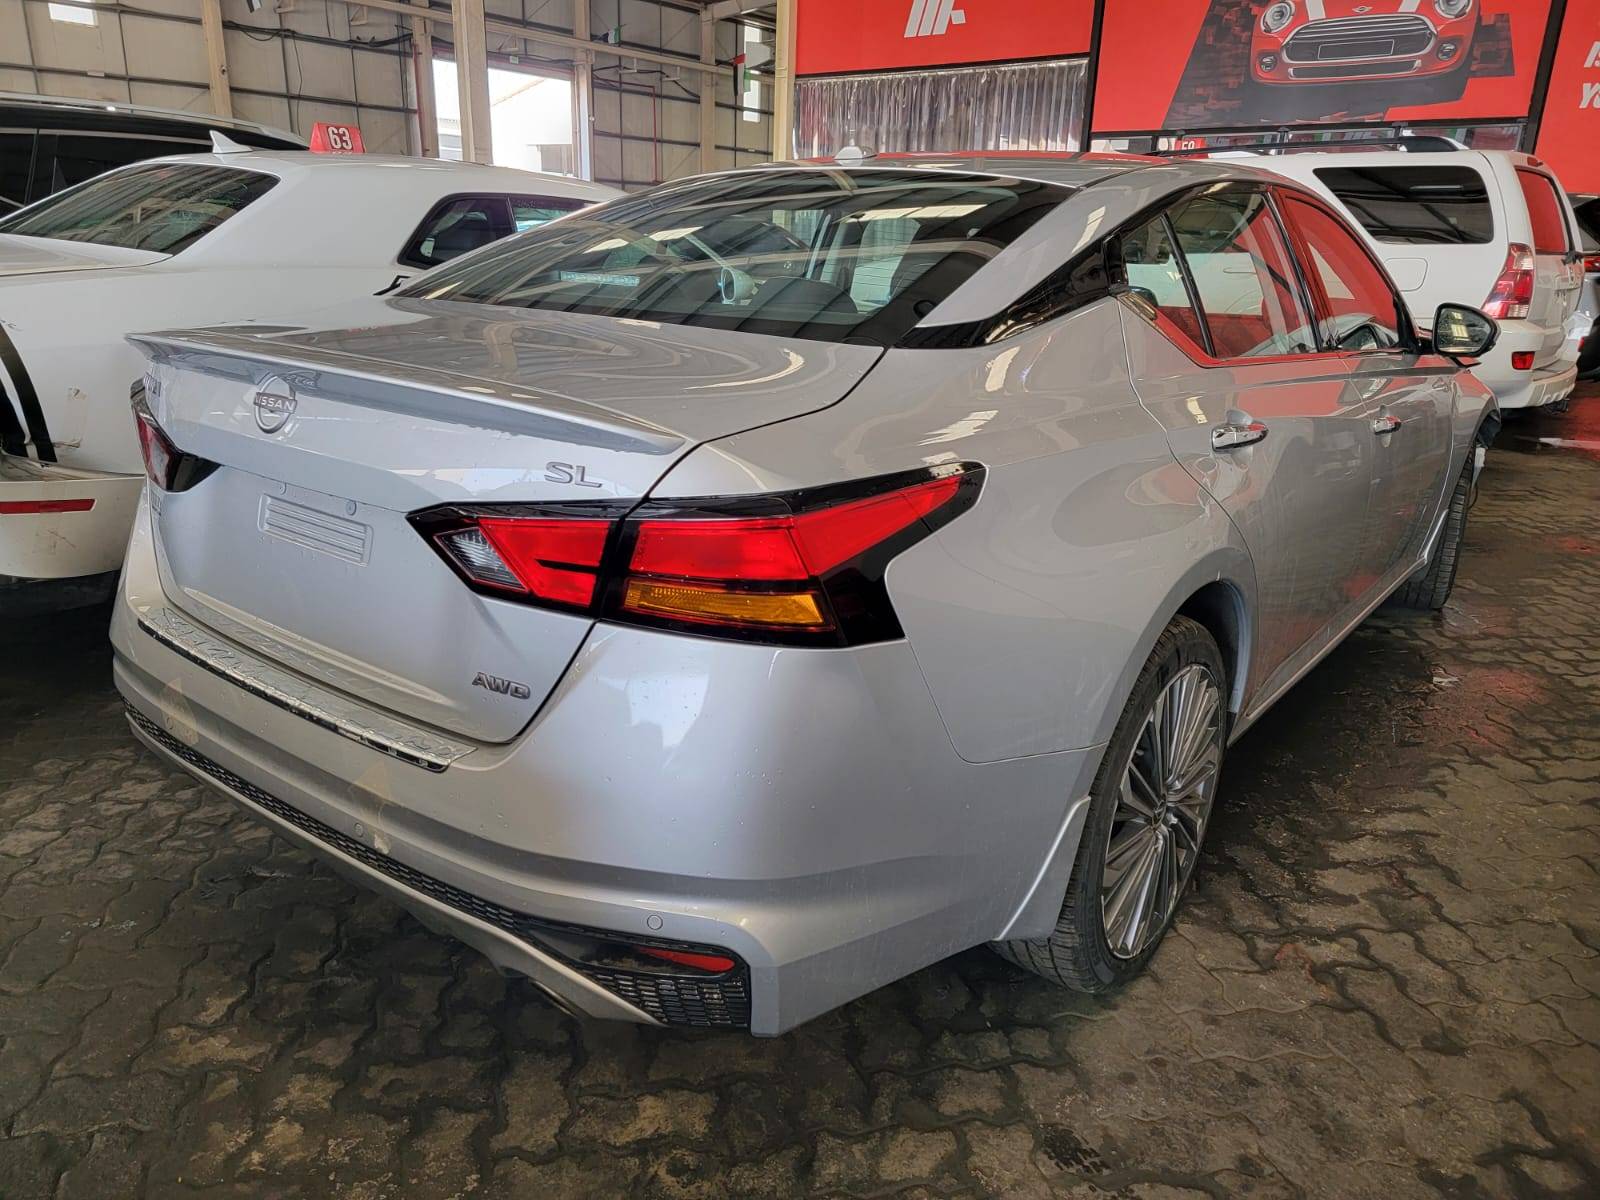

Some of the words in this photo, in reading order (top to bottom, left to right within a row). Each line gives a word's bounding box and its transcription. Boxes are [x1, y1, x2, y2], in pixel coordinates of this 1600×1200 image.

[327, 126, 353, 150] 63
[255, 393, 296, 412] NISSAN
[544, 461, 603, 488] SL
[471, 671, 531, 700] AWD
